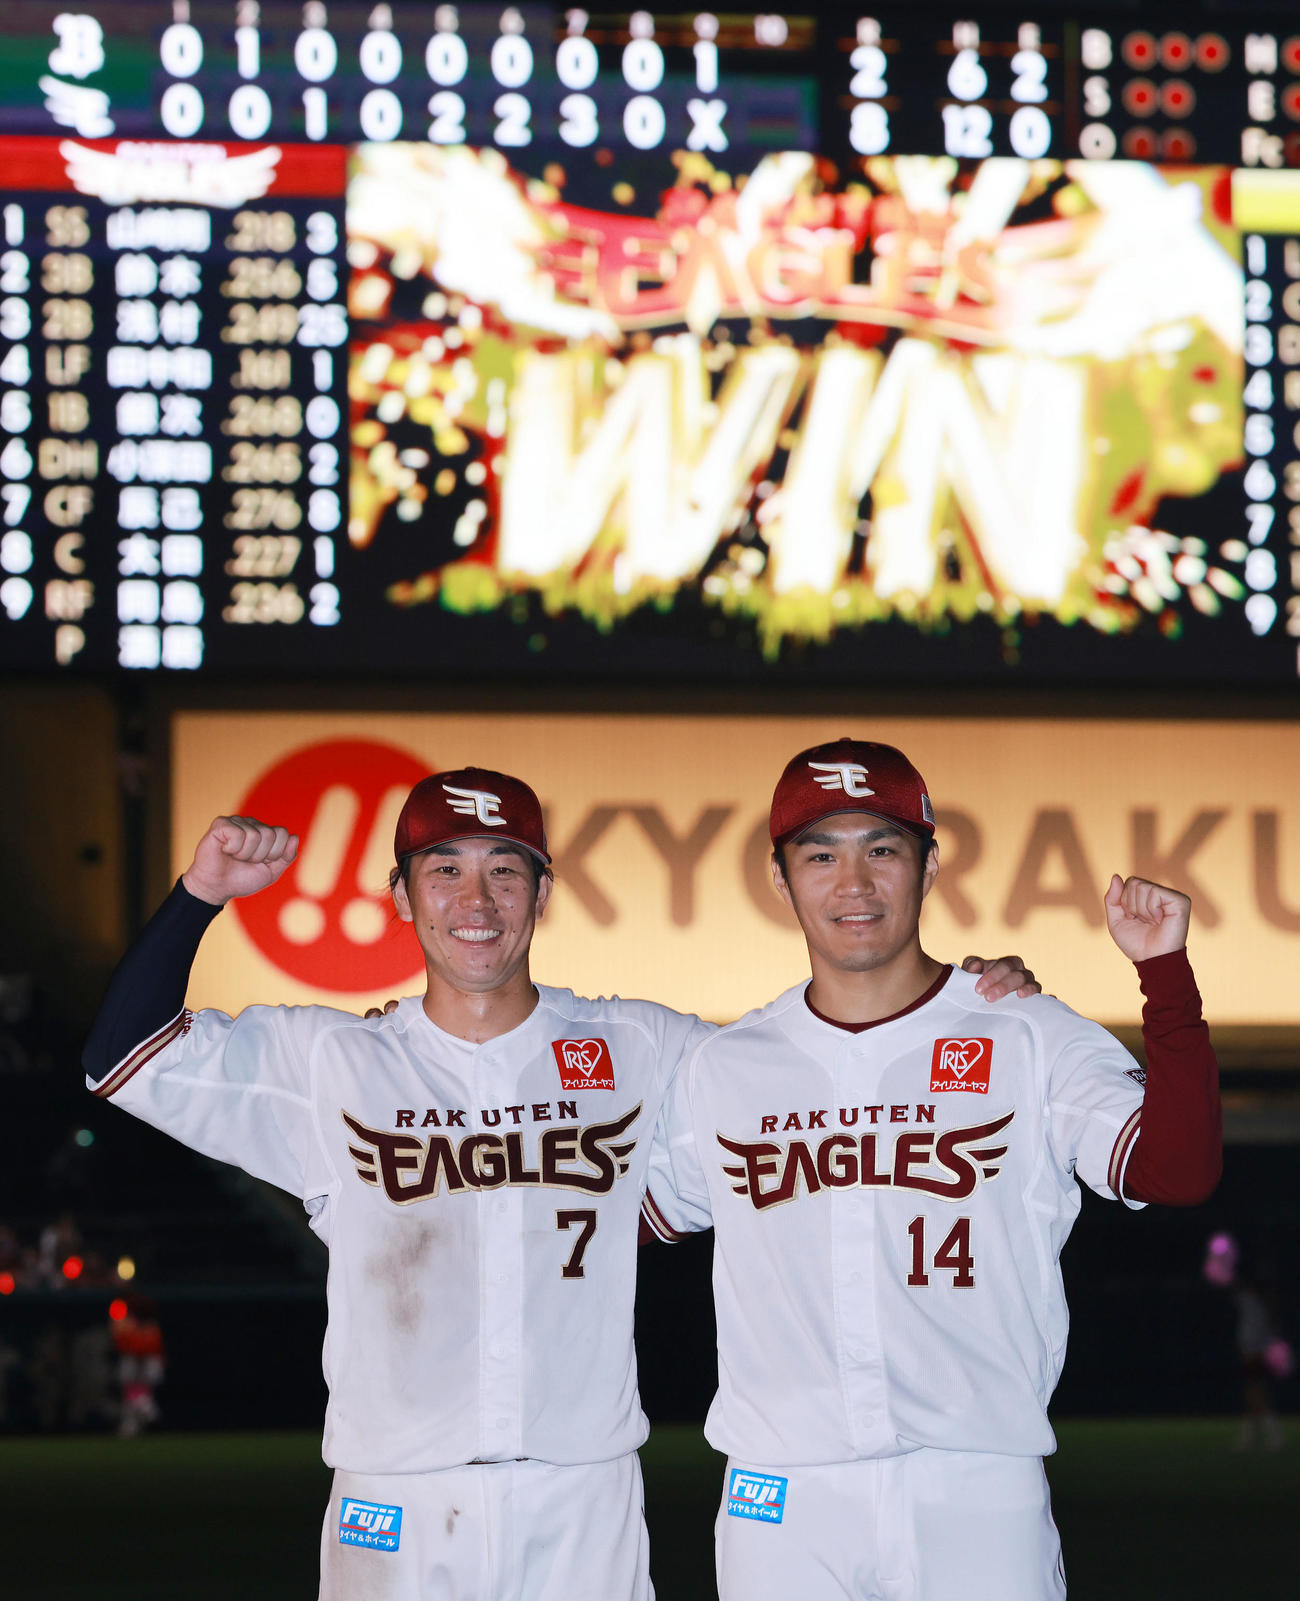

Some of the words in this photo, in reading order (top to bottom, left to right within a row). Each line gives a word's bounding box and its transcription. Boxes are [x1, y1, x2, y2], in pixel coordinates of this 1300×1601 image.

[161, 24, 203, 78] 0
[235, 26, 260, 79] 1
[295, 28, 338, 82] 0
[360, 31, 402, 84] 0
[426, 32, 468, 86] 0
[491, 34, 533, 88] 0
[557, 36, 598, 90] 0
[622, 38, 664, 92] 0
[694, 40, 718, 93] 1
[1082, 29, 1112, 69] B
[850, 45, 887, 99] 2
[948, 49, 987, 101] 6
[1011, 50, 1048, 102] 2
[161, 83, 203, 137] 0
[229, 85, 271, 139] 0
[303, 87, 327, 141] 1
[360, 89, 402, 142] 0
[428, 91, 466, 144] 2
[494, 93, 532, 147] 2
[559, 94, 599, 147] 3
[623, 96, 665, 150] 0
[687, 99, 728, 152] X
[1084, 76, 1111, 117] S
[850, 101, 890, 155] 8
[942, 104, 993, 157] 12
[1010, 106, 1051, 159] 0
[1080, 122, 1116, 160] O
[4, 204, 25, 246] 1
[306, 212, 338, 255] 3
[0, 250, 30, 293] 2
[1247, 235, 1266, 276] 1
[0, 297, 31, 339] 3
[1246, 279, 1272, 321] 2
[0, 344, 31, 386] 4
[313, 350, 333, 391] 1
[1243, 369, 1274, 411] 4
[306, 396, 339, 439] 0
[1, 438, 33, 480] 6
[309, 443, 339, 485] 2
[497, 335, 1092, 600] WIN
[1244, 459, 1276, 502] 6
[1, 484, 31, 526] 7
[1245, 503, 1275, 545] 7
[54, 533, 85, 574] C
[314, 536, 334, 578] 1
[0, 577, 33, 620] 9
[309, 582, 340, 625] 2
[1245, 593, 1277, 636] 9
[56, 624, 85, 665] P
[563, 1051, 592, 1069] IRIS
[939, 1050, 969, 1070] IRIS
[563, 1078, 614, 1089] アイリスオーヤマ
[931, 1080, 987, 1092] アイリスオーヤマ
[395, 1100, 579, 1128] RAKUTEN
[760, 1104, 936, 1134] RAKUTEN
[341, 1100, 643, 1206] EAGLES
[716, 1106, 1015, 1213] EAGLES
[555, 1208, 598, 1280] 7
[906, 1214, 976, 1289] 14
[732, 1473, 782, 1504] Fuji
[342, 1502, 396, 1534] Fuji
